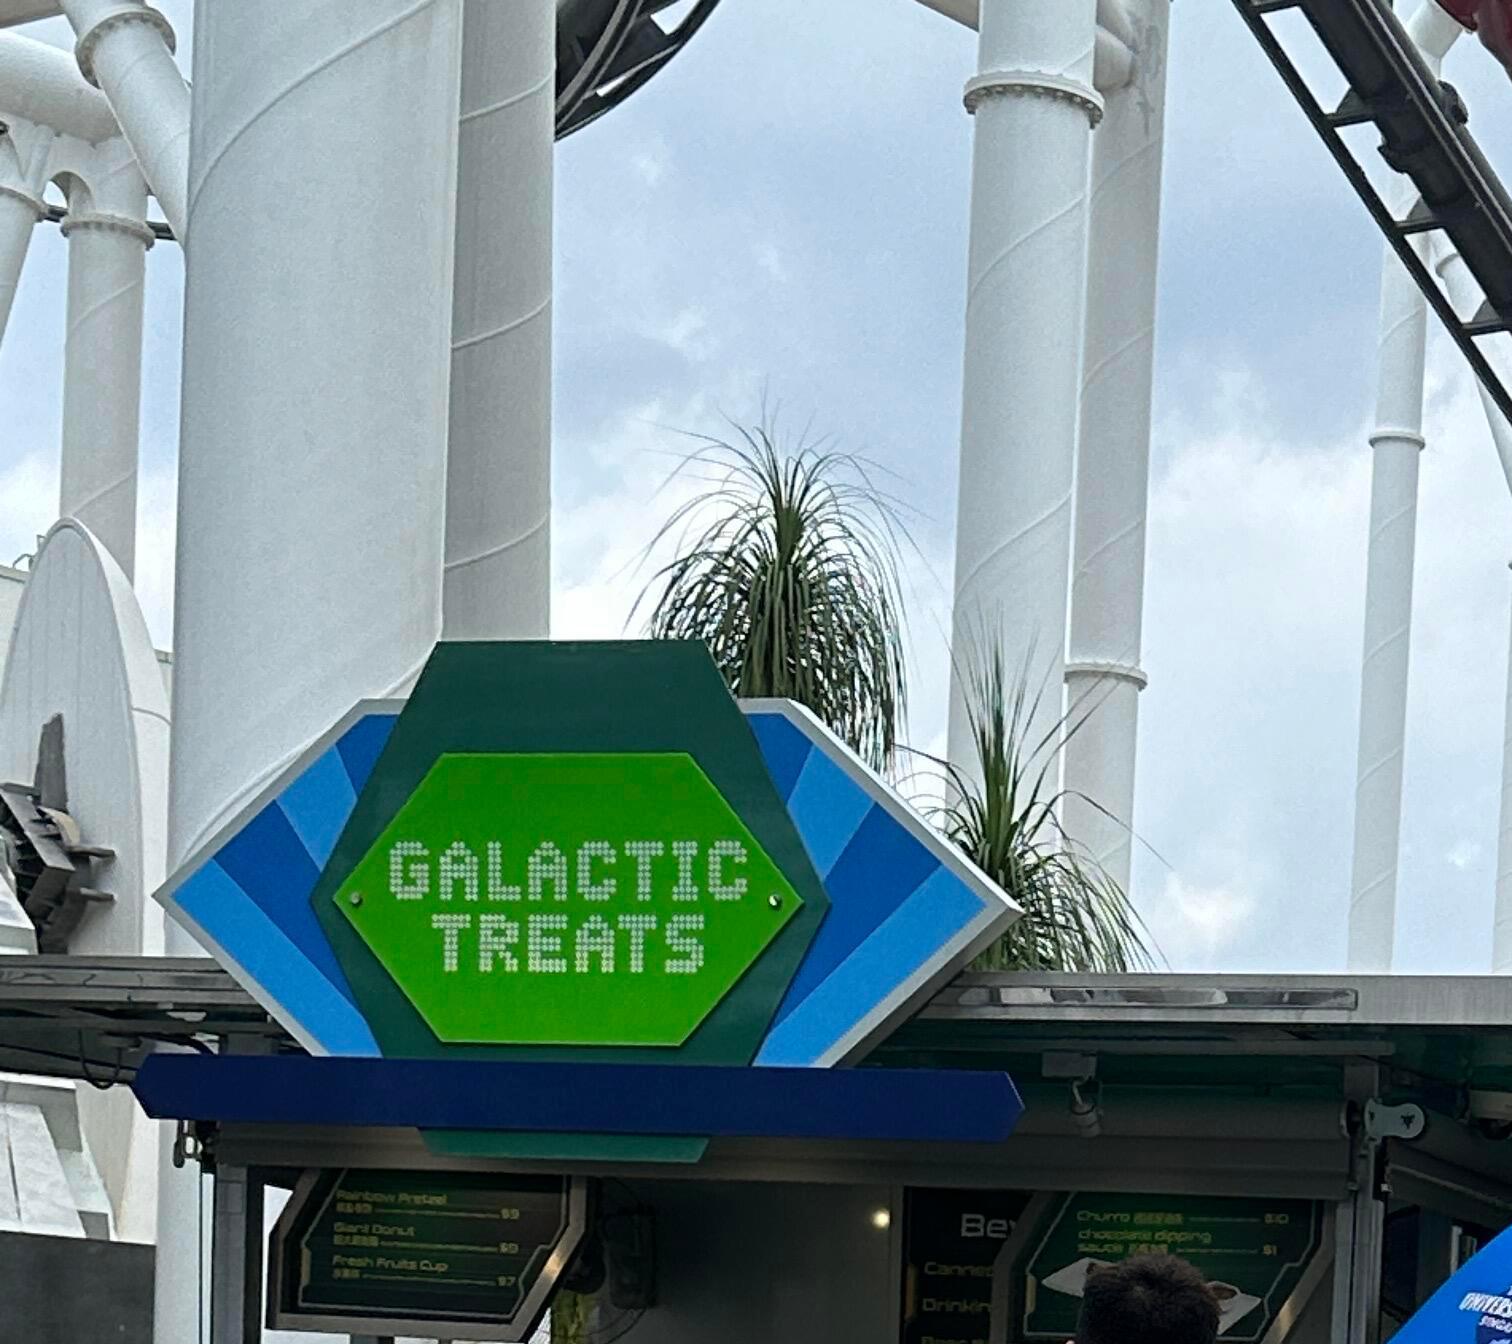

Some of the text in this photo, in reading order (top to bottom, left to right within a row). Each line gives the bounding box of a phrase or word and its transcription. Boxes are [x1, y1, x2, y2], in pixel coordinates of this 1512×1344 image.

[388, 839, 749, 904] GALACTIC
[431, 912, 706, 975] TREATS
[335, 1190, 448, 1206] Rainbow Pretzel
[1076, 1209, 1132, 1223] Churro
[372, 1224, 416, 1237] Donut
[1154, 1230, 1213, 1245] dipping
[332, 1255, 374, 1267] Fresh
[419, 1260, 449, 1273] Cup
